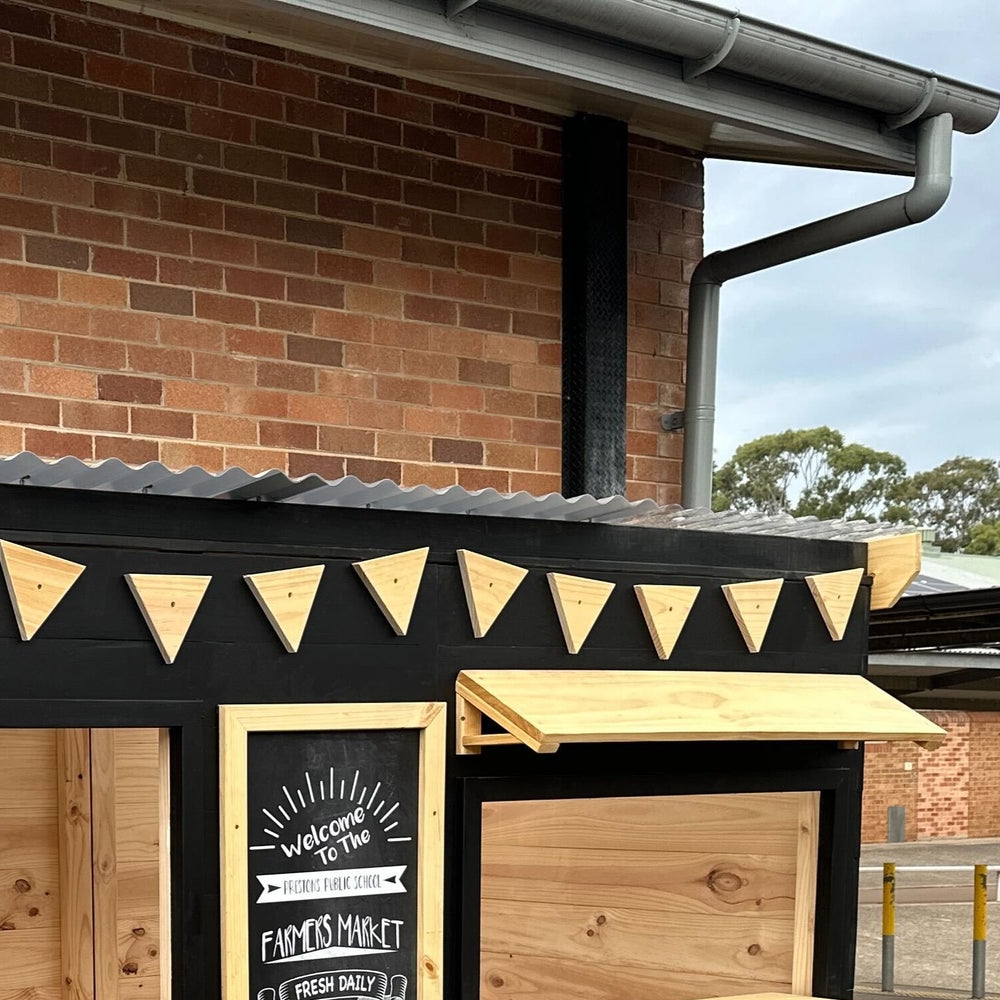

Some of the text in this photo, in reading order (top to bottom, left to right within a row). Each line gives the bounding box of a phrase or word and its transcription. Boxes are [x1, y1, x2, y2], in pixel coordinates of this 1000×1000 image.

[281, 807, 366, 857] Welcome
[313, 829, 371, 865] To The
[324, 876, 351, 892] PUBLIC
[354, 874, 381, 890] SCHOOL
[261, 913, 404, 962] FARMERS MARKET
[294, 975, 376, 1000] FRESH DAILY
